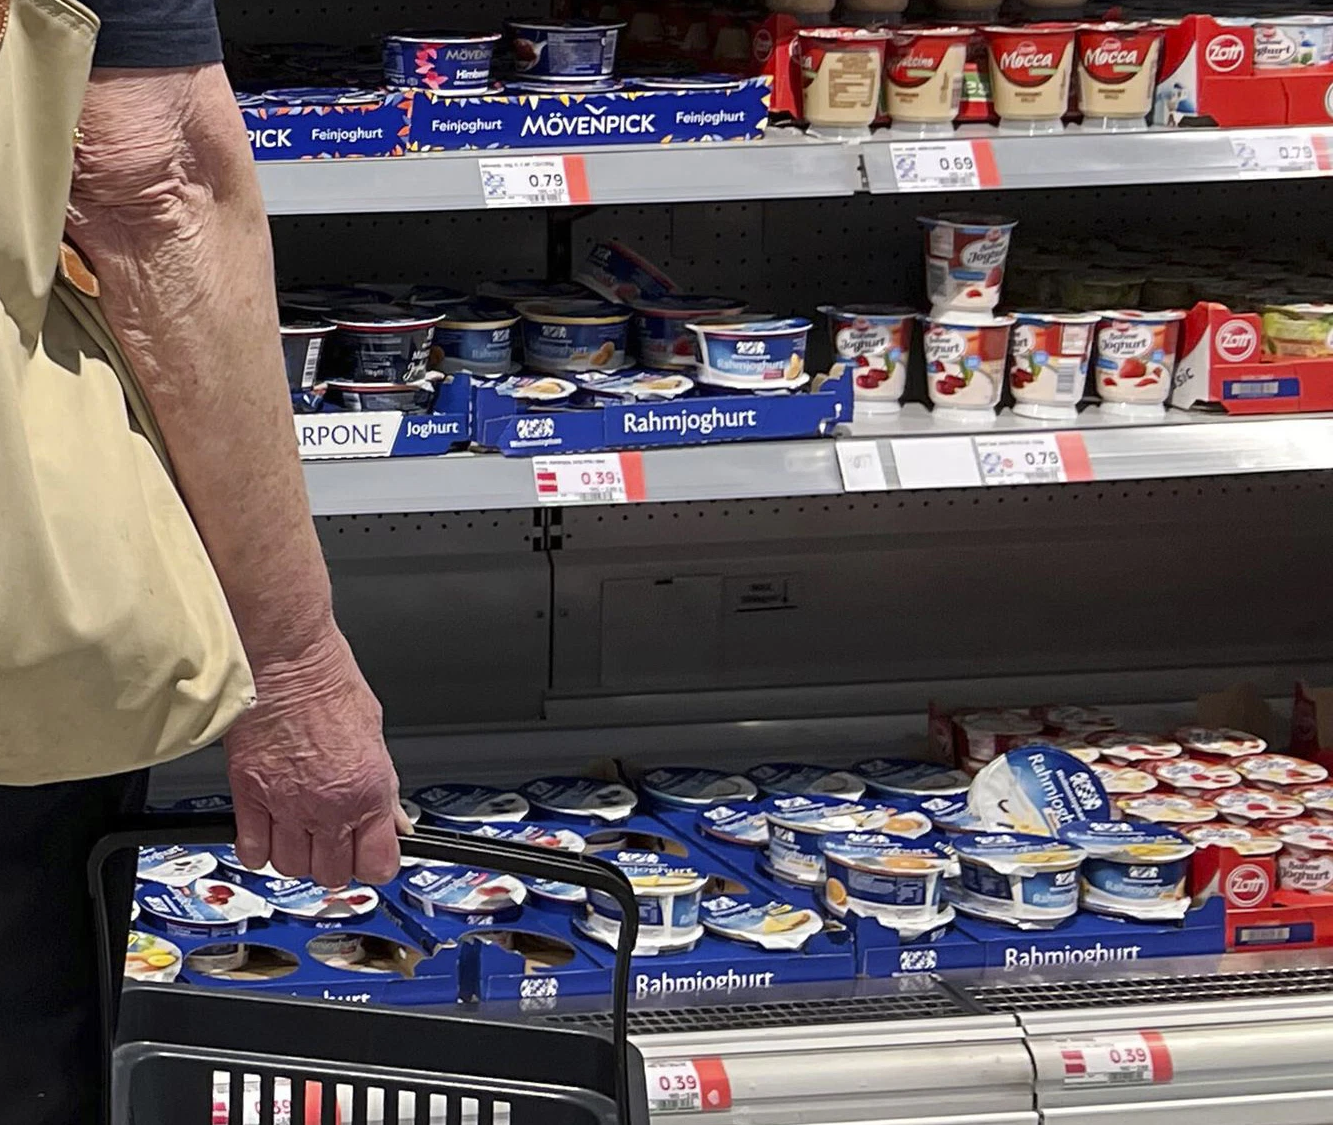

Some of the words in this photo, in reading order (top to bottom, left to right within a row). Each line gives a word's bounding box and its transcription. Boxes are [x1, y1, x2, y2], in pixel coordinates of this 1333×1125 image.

[1000, 49, 1053, 69] Mocca
[1084, 47, 1138, 66] Mocca
[431, 116, 503, 134] Feinjoghurt
[521, 113, 656, 137] MÖVENPICK
[675, 108, 746, 125] Feinjoghurt
[311, 125, 383, 142] Feinjoghurt
[939, 156, 974, 171] 0.69
[404, 419, 460, 439] Joghurt
[623, 407, 757, 436] Rahmjoghurt
[581, 471, 615, 486] 0.39
[1109, 1047, 1147, 1064] 0.39
[658, 1074, 698, 1091] 0.39
